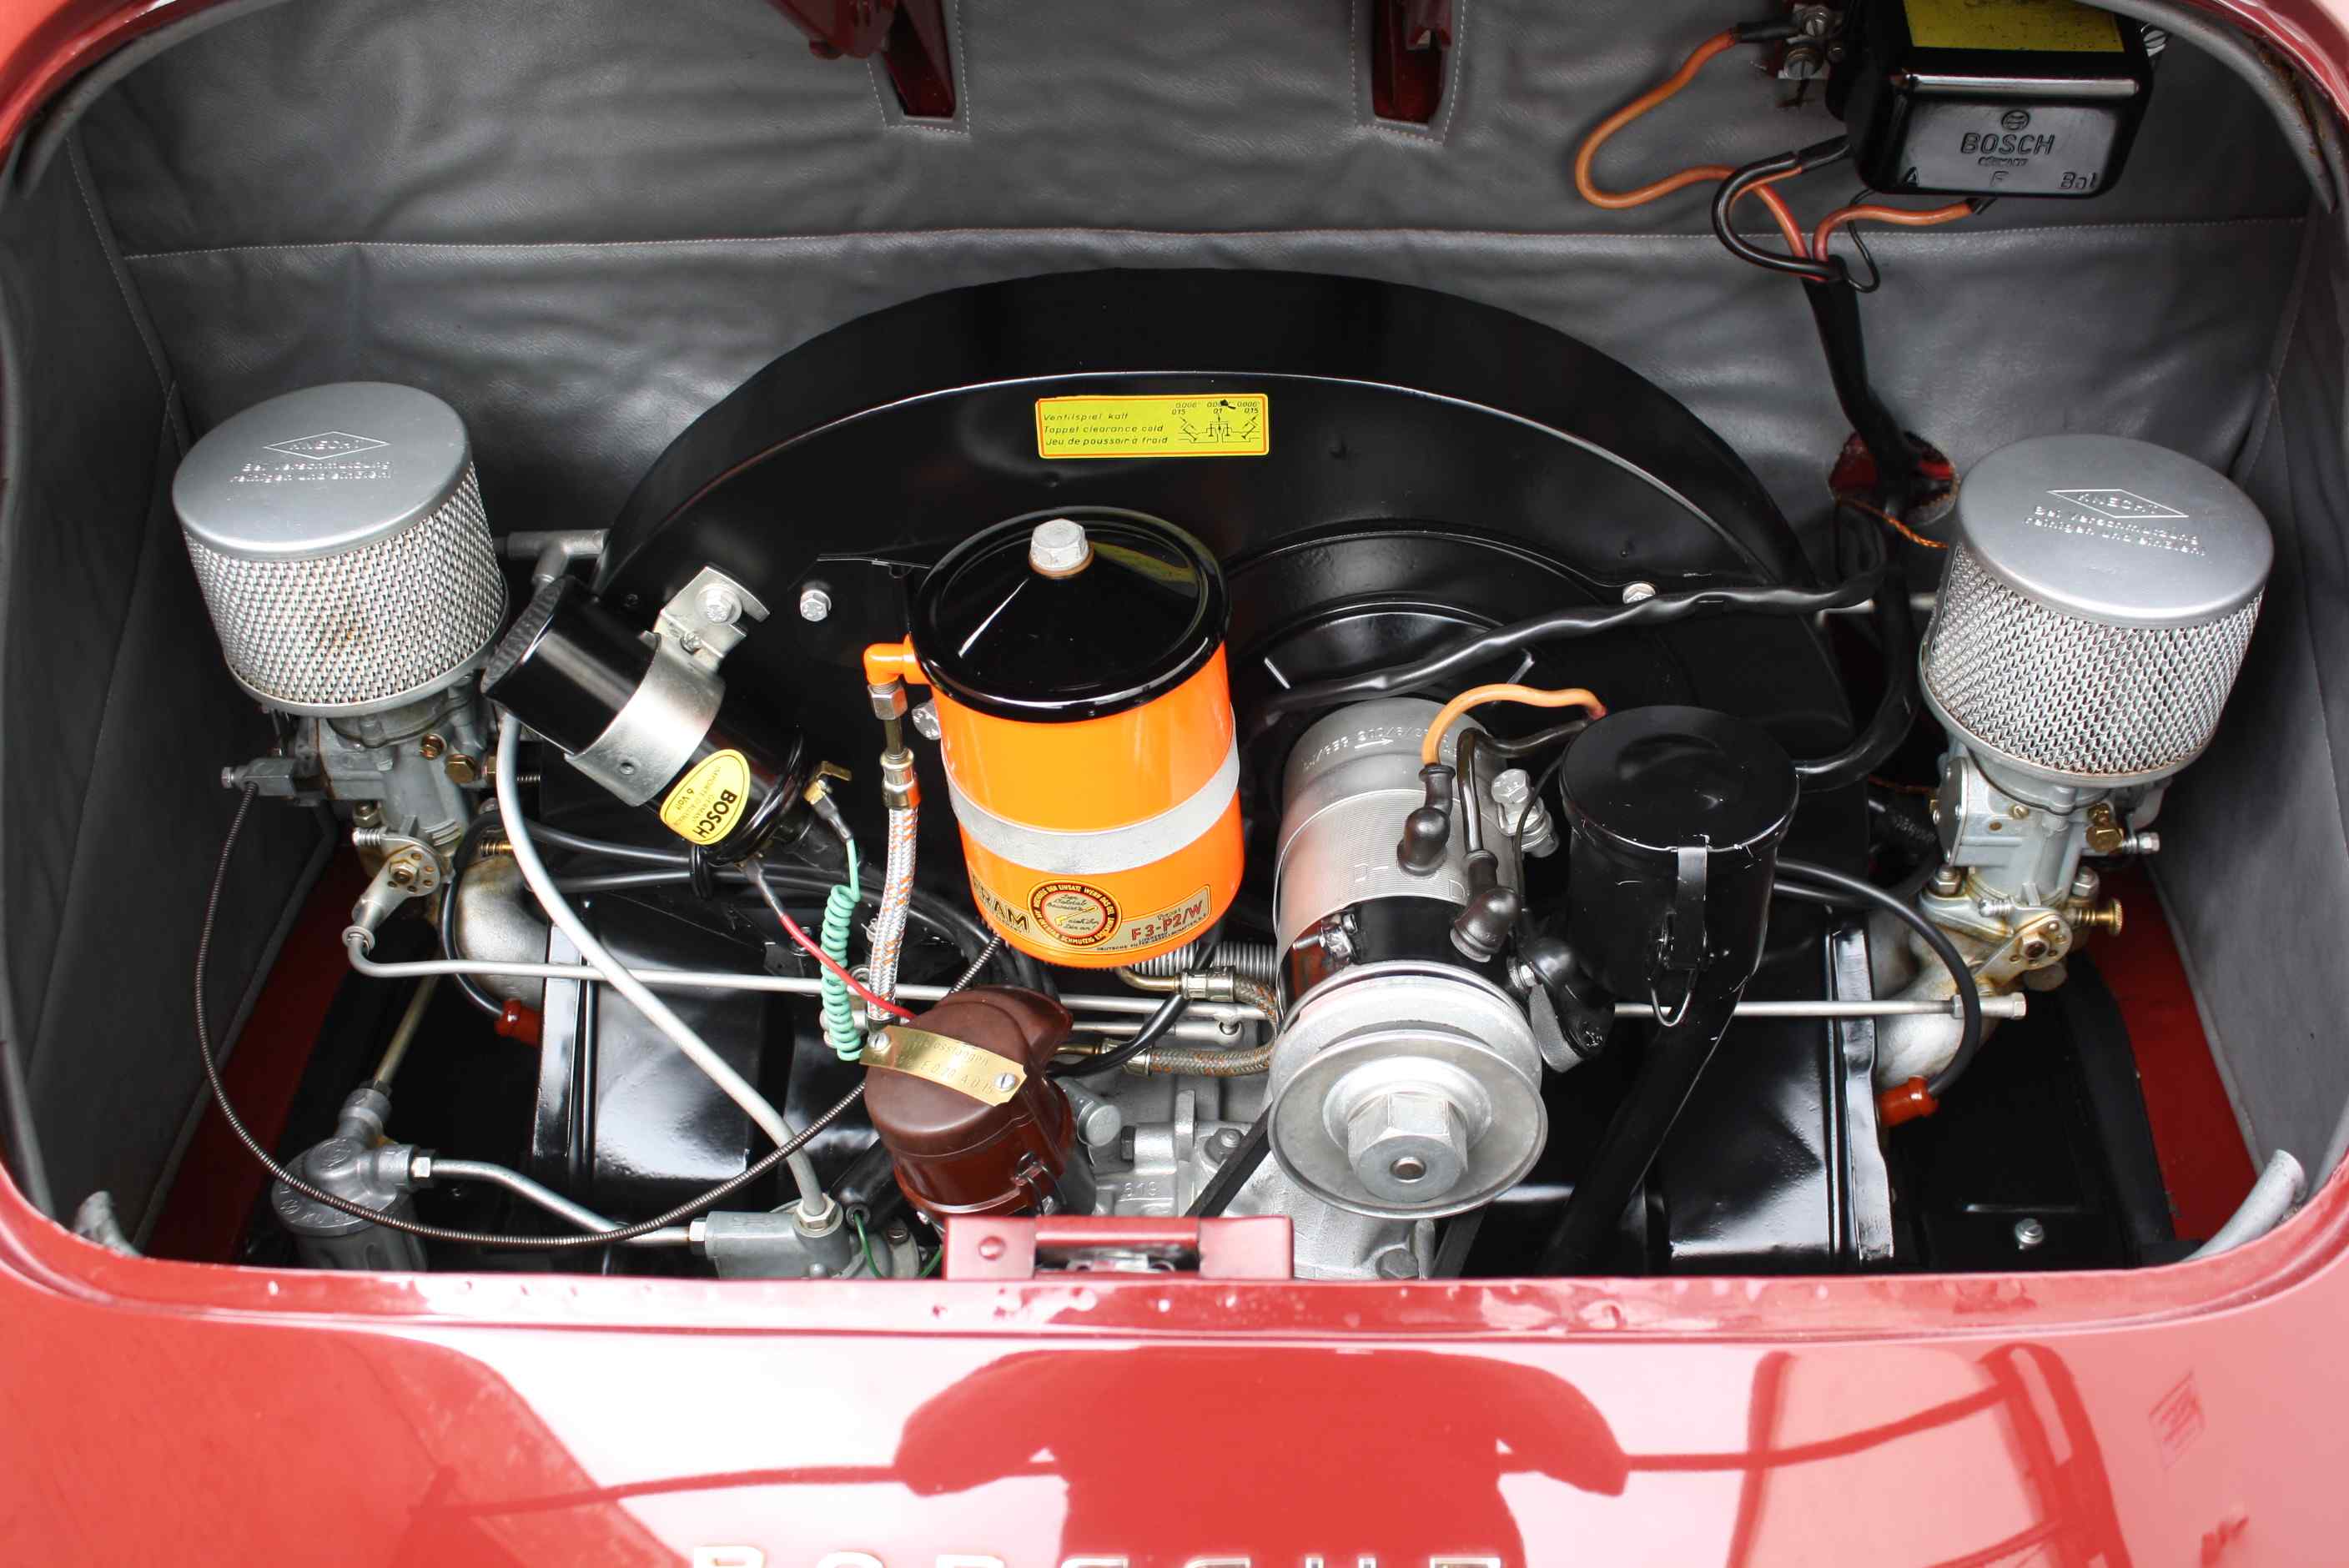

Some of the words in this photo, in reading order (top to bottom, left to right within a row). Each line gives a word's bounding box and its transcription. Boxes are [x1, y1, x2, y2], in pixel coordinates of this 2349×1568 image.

[1960, 132, 2055, 154] BOSCH
[1043, 413, 1102, 422] Ventilspiel
[1108, 412, 1129, 420] kalt
[1044, 425, 1080, 434] Tappet
[1068, 437, 1080, 445] de
[1142, 436, 1169, 445] froid
[692, 789, 737, 838] BOSCH
